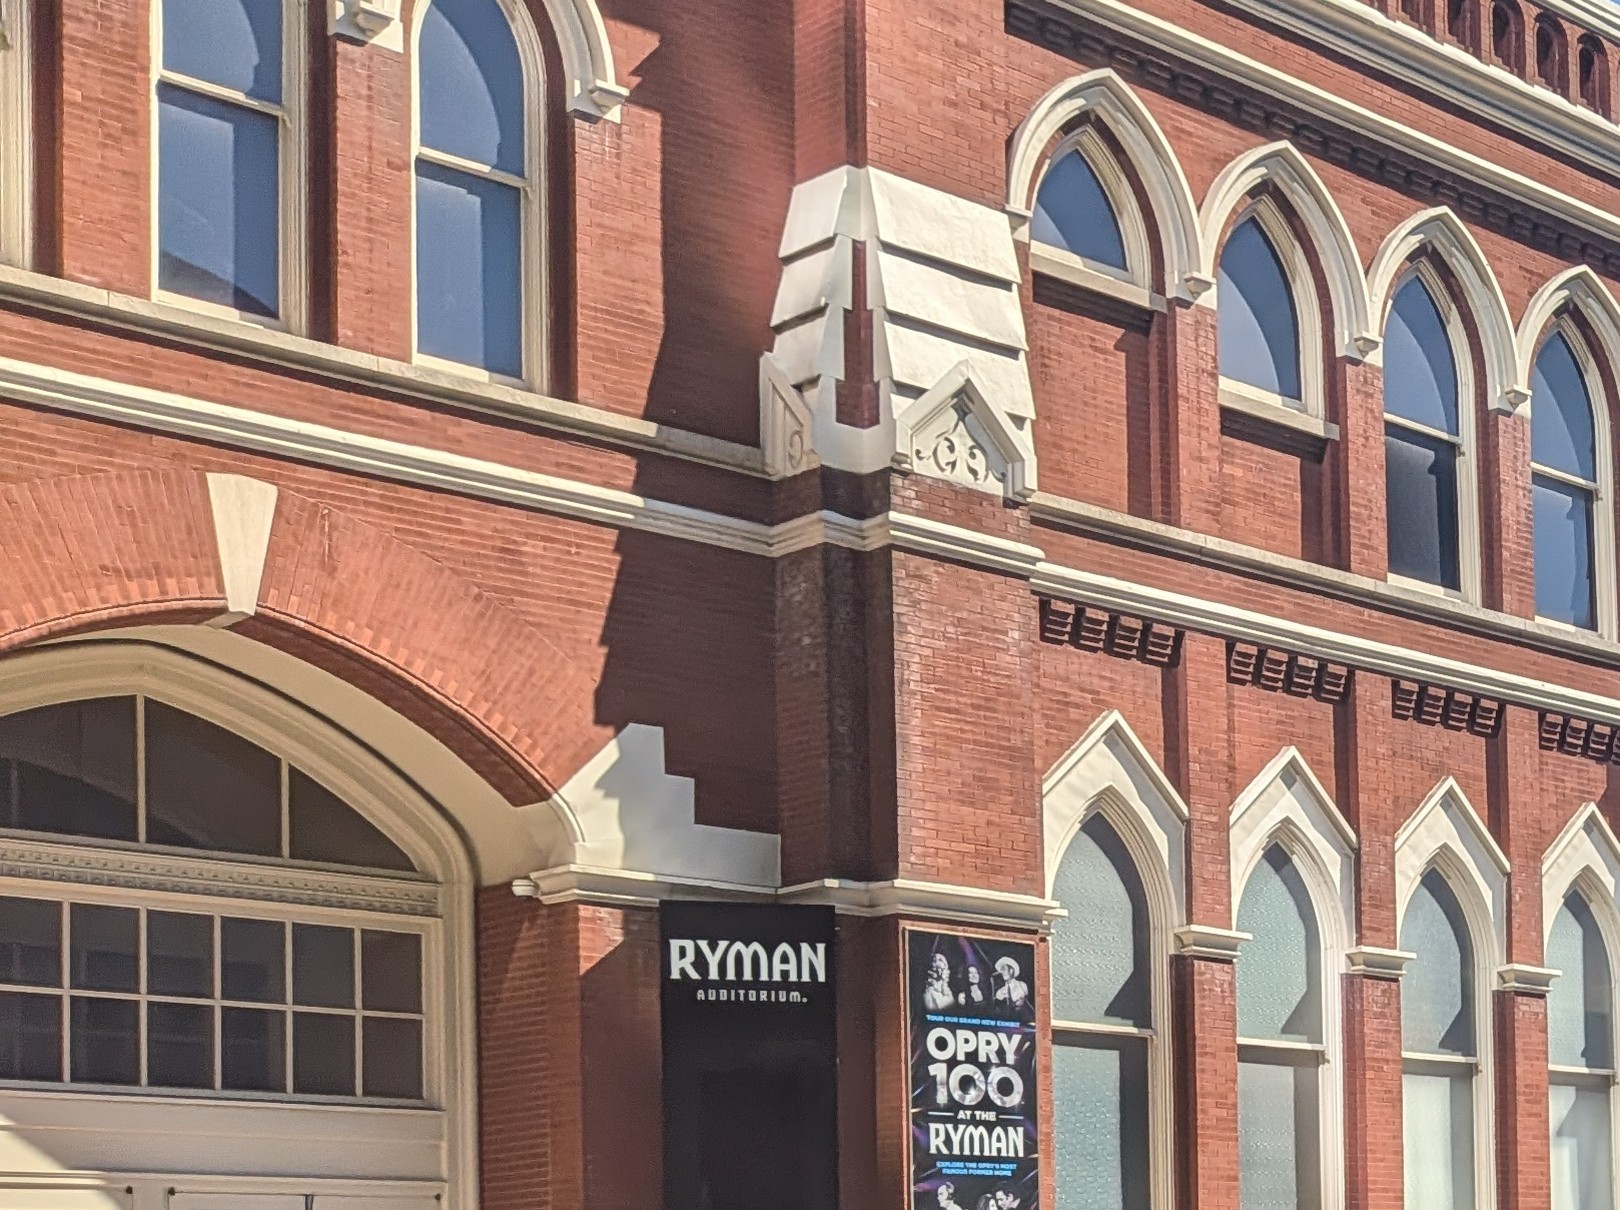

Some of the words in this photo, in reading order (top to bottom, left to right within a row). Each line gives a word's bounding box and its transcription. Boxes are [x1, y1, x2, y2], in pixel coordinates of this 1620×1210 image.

[669, 938, 827, 983] RYMAN
[926, 1027, 1022, 1065] OPRY
[927, 1062, 1024, 1108] 100
[957, 1109, 972, 1120] AT
[974, 1110, 997, 1121] THE
[928, 1122, 1024, 1158] RYMAN
